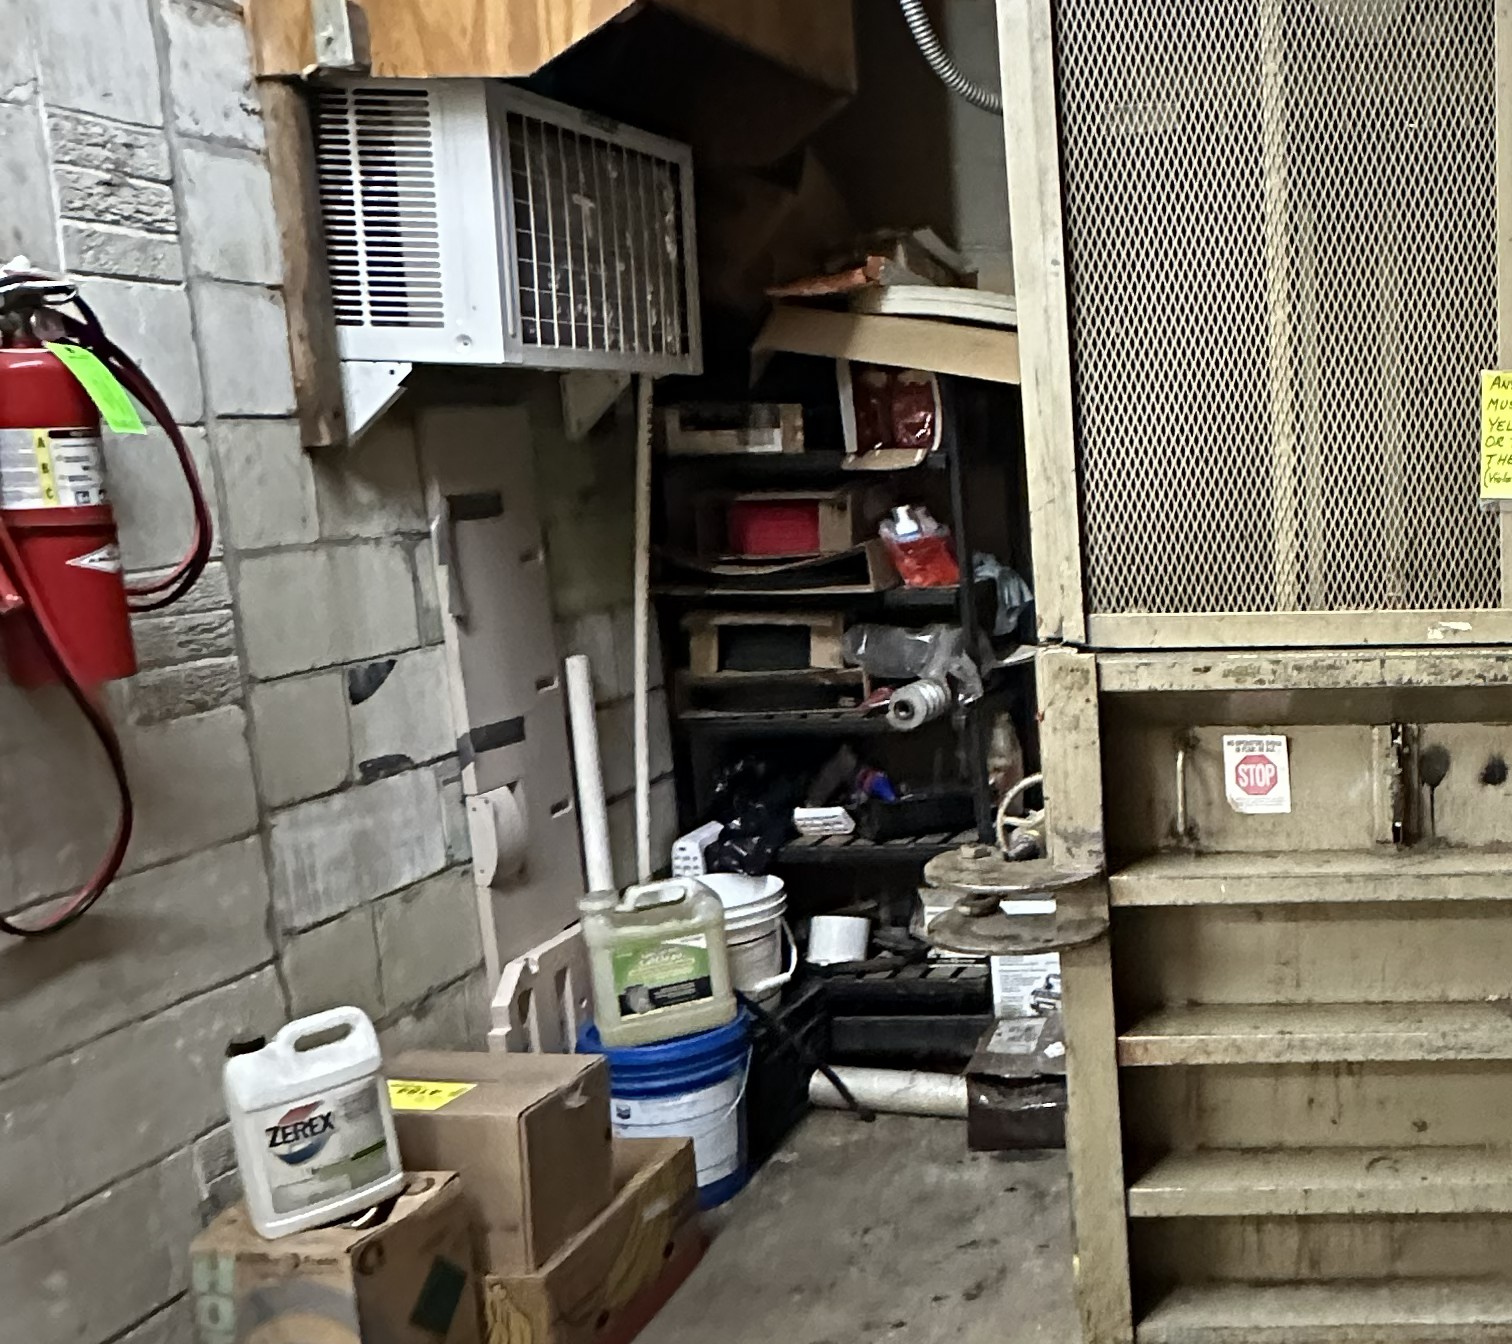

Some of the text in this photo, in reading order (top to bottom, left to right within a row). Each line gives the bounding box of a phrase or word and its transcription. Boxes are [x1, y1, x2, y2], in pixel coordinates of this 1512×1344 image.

[37, 436, 46, 448] A
[1485, 435, 1504, 448] OR
[46, 488, 54, 499] C
[1237, 762, 1276, 788] STOP
[264, 1111, 335, 1148] ZEREX
